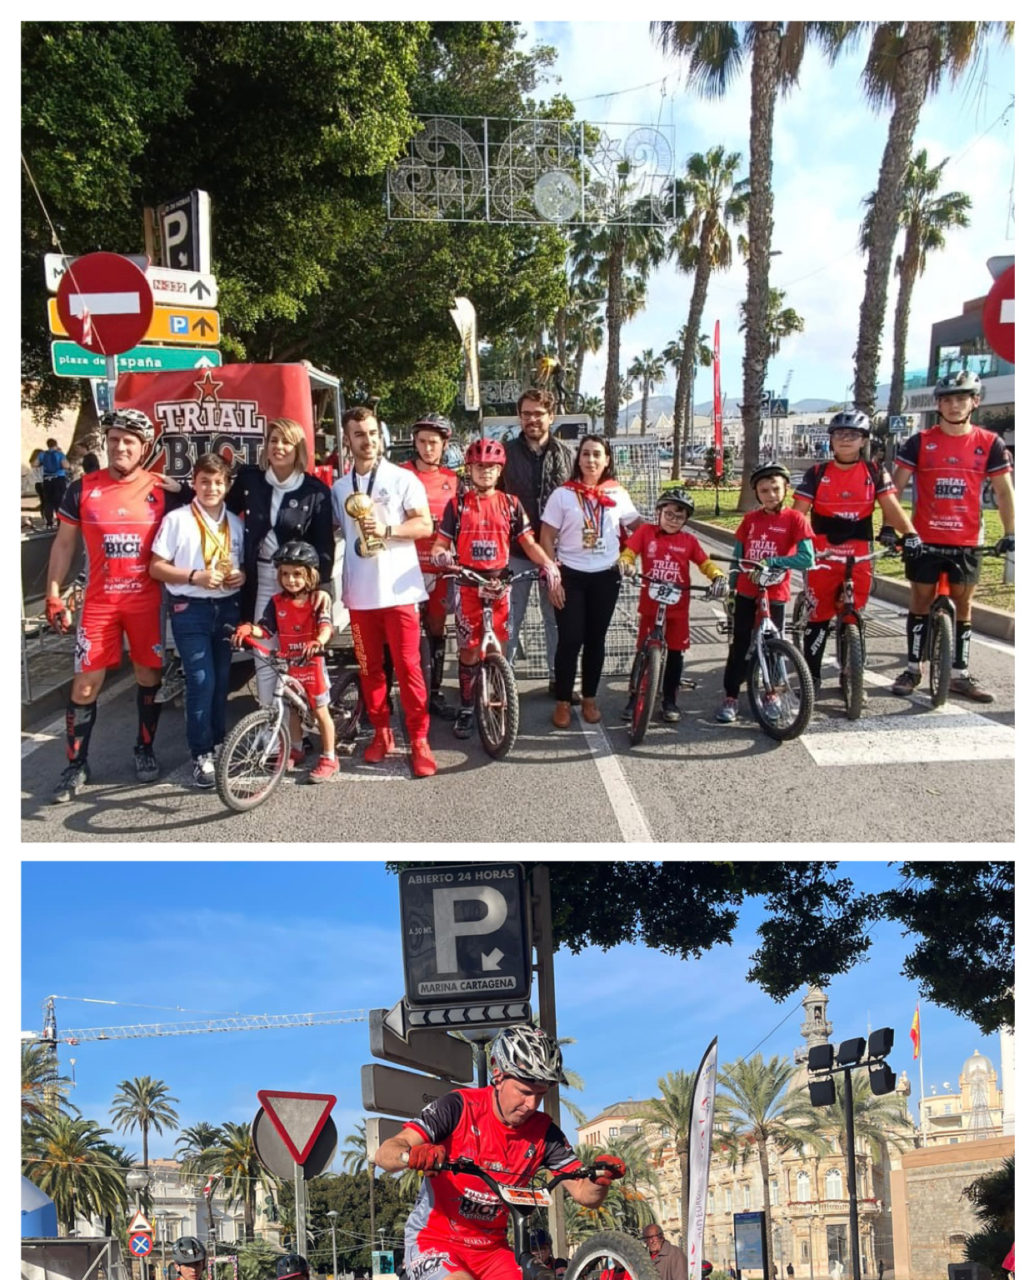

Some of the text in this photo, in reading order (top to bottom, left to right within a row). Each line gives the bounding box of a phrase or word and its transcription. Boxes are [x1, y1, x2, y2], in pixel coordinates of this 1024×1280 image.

[59, 355, 88, 365] plaza
[156, 401, 264, 435] TRIAL
[163, 434, 264, 478] BICI
[935, 485, 966, 496] BICI
[105, 542, 140, 553] BICI
[750, 540, 776, 550] TRIAL
[472, 547, 497, 557] BICI
[653, 560, 680, 571] TRIAL
[653, 570, 680, 583] BICI
[657, 586, 673, 598] 87
[408, 868, 515, 885] ABIERTO 24 HORAS
[432, 885, 508, 974] P
[420, 978, 514, 994] MARINA CARTAGENA
[460, 1200, 501, 1216] BICI
[411, 1256, 444, 1280] BICI
